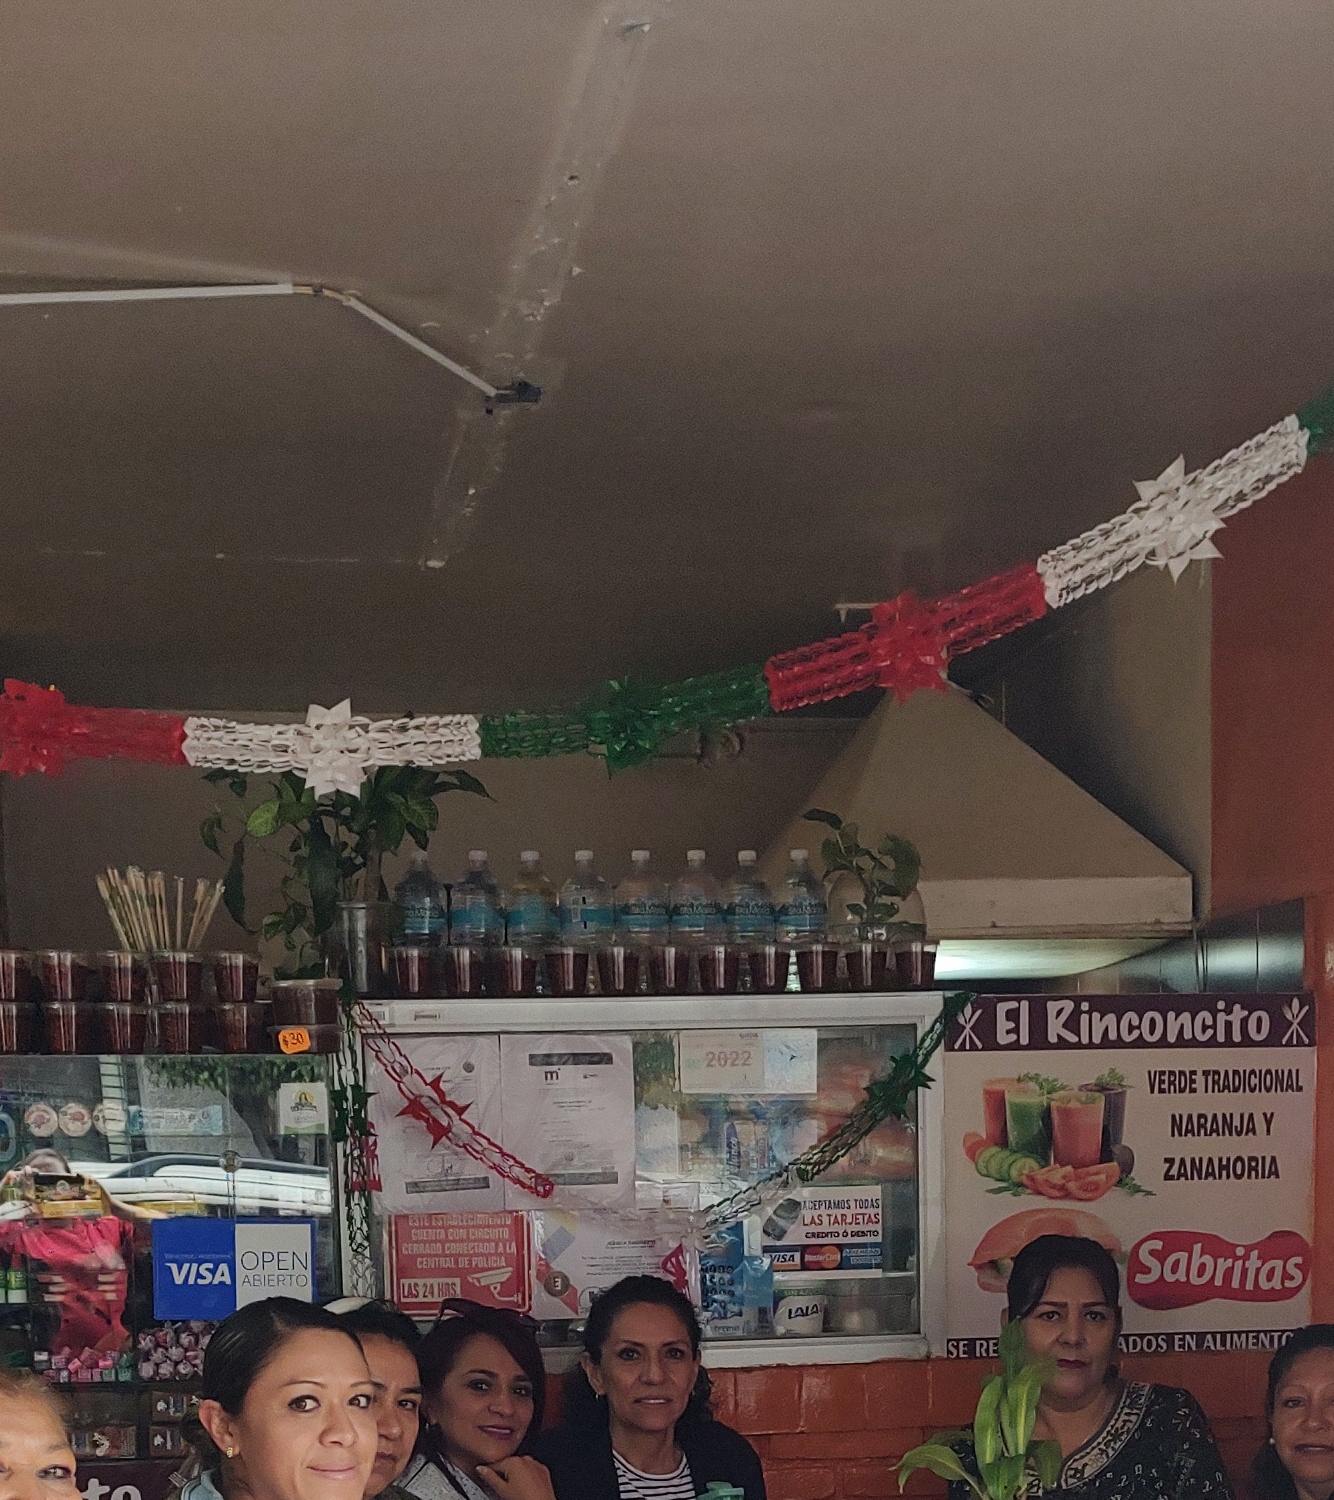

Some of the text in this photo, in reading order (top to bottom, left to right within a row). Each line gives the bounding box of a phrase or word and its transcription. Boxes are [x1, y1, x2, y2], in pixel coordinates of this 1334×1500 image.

[996, 1000, 1271, 1046] El Rinconcito
[705, 1051, 752, 1068] 2022
[1147, 1068, 1304, 1095] VERDE TRADICIONAL
[1170, 1112, 1275, 1138] NARANJA Y
[1163, 1156, 1281, 1181] ZANAHORIA
[802, 1198, 880, 1210] ACEPTAMOS TODAS
[802, 1213, 880, 1227] LAS TARJETAS
[240, 1250, 308, 1271] OPEN
[769, 1252, 796, 1264] VISA
[1135, 1239, 1304, 1291] Sabritas
[165, 1262, 232, 1285] VISA
[241, 1273, 308, 1287] ABIERTO
[402, 1281, 421, 1299] LAS
[423, 1282, 434, 1298] 24
[948, 1341, 969, 1359] SE
[1174, 1332, 1197, 1352] EN
